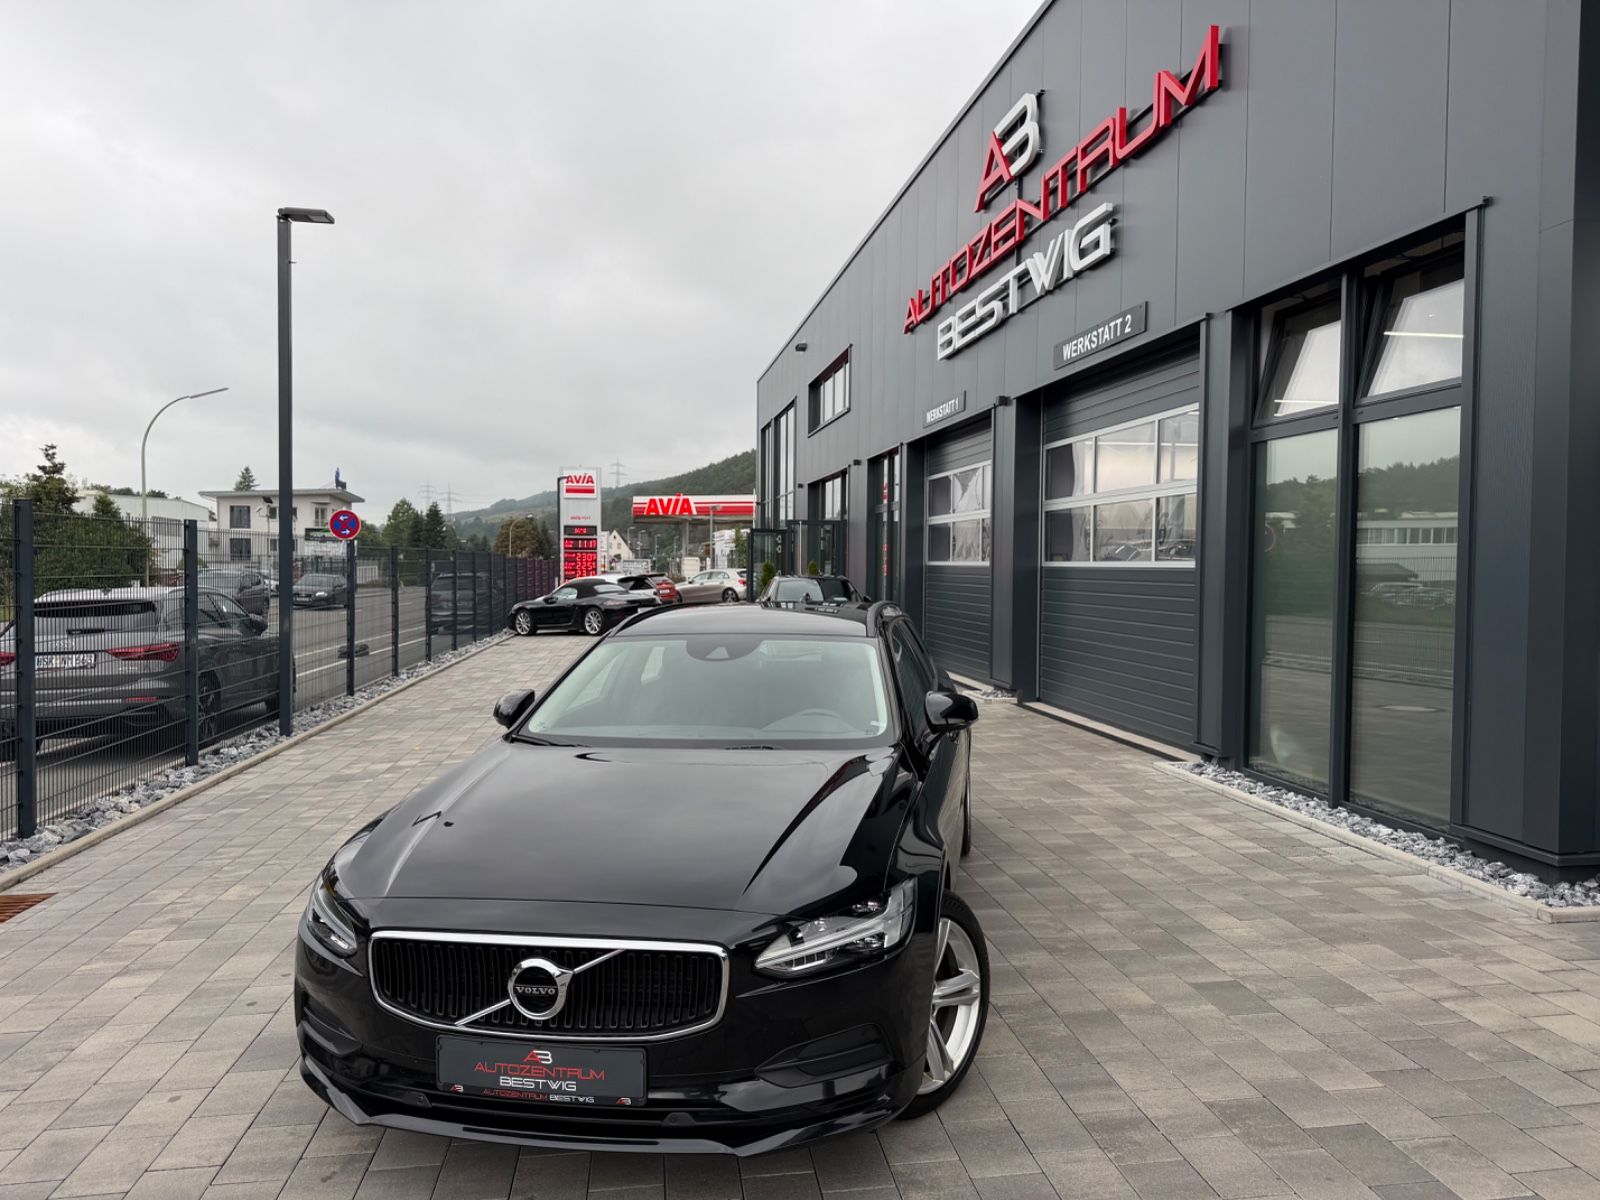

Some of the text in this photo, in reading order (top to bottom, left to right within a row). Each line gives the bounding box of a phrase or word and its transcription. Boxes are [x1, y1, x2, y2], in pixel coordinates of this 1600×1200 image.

[903, 24, 1220, 335] AUTOZENTRUM
[937, 202, 1114, 361] BESTWIG
[1062, 313, 1133, 361] WERKSTATT 2
[926, 400, 954, 424] WERKSTATT
[515, 985, 556, 996] VOLVO
[474, 1062, 605, 1081] AUTOZENTRUM
[499, 1077, 577, 1092] BESTWIG
[482, 1089, 548, 1101] AUTOZENTRUM
[549, 1094, 595, 1104] BESTWIG
